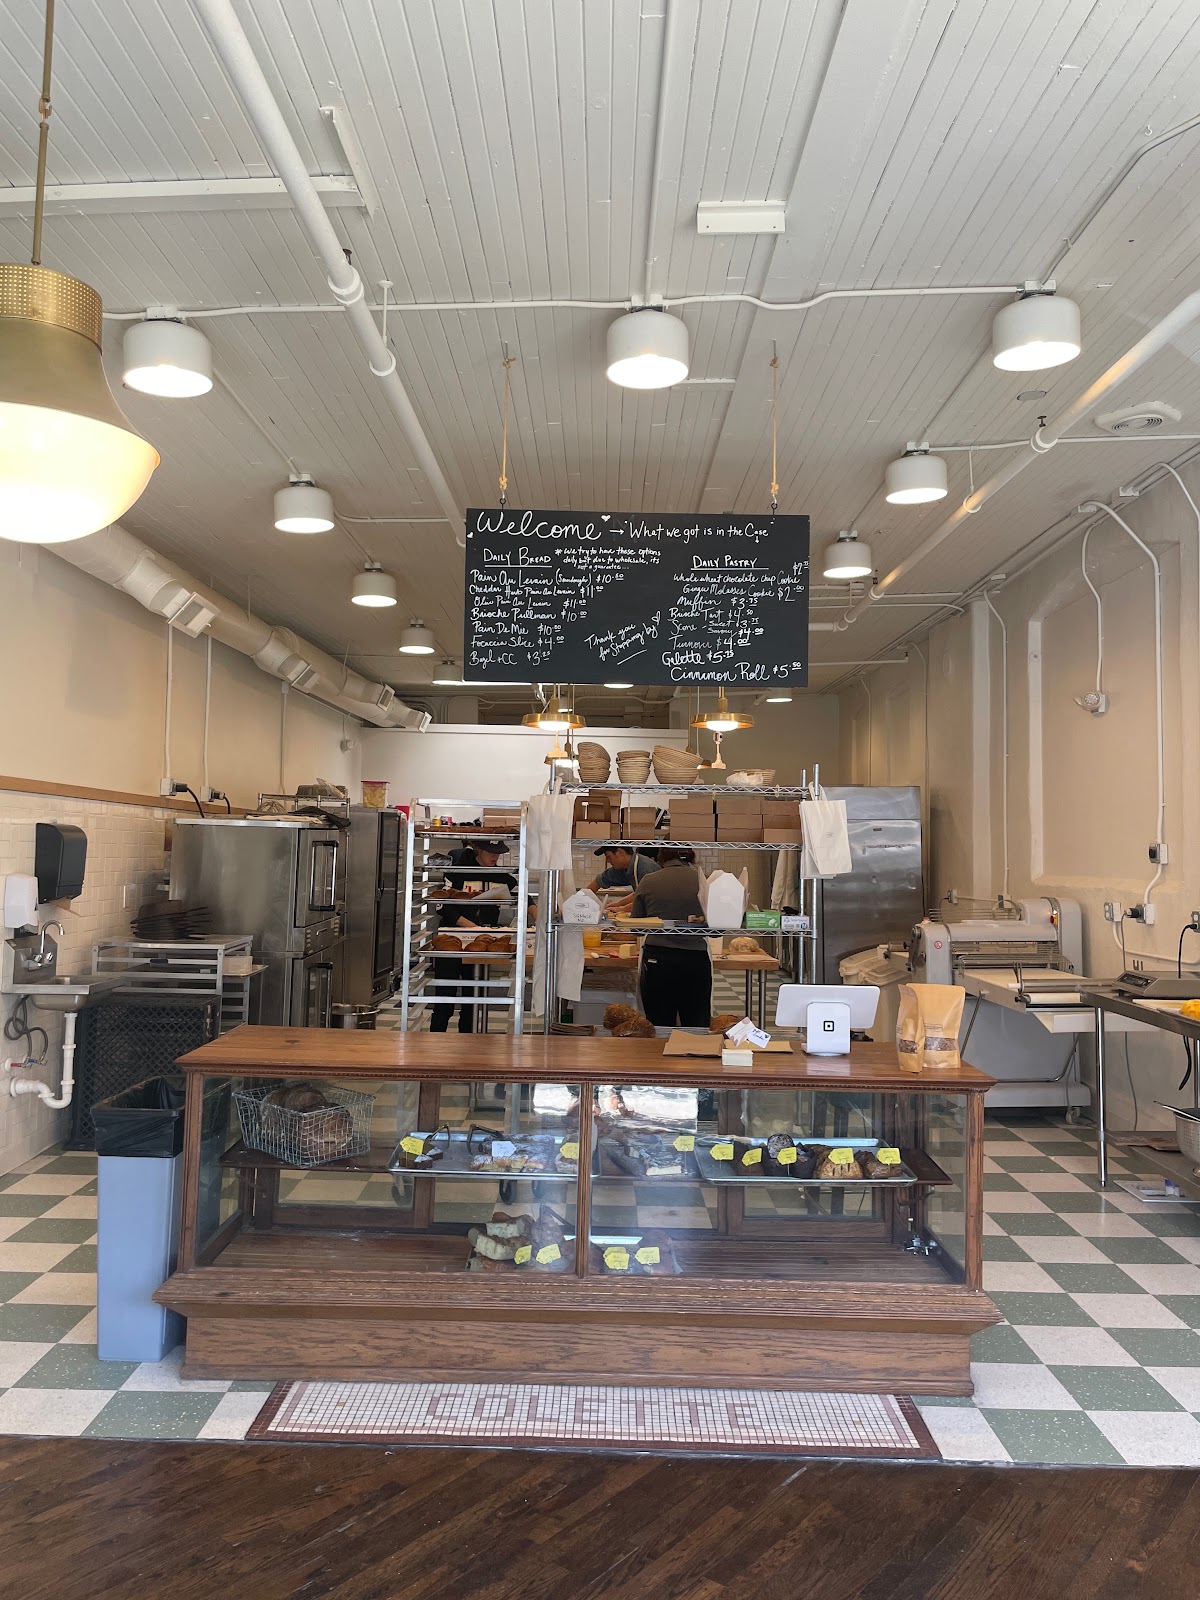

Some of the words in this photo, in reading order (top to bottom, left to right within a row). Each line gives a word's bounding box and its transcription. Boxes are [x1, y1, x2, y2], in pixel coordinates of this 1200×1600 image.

[476, 510, 601, 540] Welcome
[629, 520, 665, 540] What
[666, 527, 682, 538] we
[683, 523, 700, 543] got
[703, 527, 713, 536] is
[716, 526, 725, 537] in
[727, 524, 743, 536] the
[483, 547, 511, 566] DAILY
[518, 546, 552, 567] BREAD
[578, 545, 590, 559] try
[590, 546, 598, 555] to
[598, 546, 616, 555] have
[616, 546, 636, 555] these
[638, 546, 661, 558] options
[562, 555, 578, 567] daily
[692, 555, 719, 569] DAILY
[724, 554, 758, 568] PASTRY
[470, 568, 497, 584] Pain
[499, 570, 516, 586] Au
[518, 569, 553, 587] Levain
[468, 584, 502, 596] Cheddar
[524, 586, 542, 597] Pain
[747, 584, 775, 597] Cookie
[495, 595, 511, 608] Pain
[512, 596, 525, 606] Au
[527, 597, 552, 610] Levain
[676, 595, 722, 611] Muffin
[470, 607, 510, 621] Brioche
[511, 607, 557, 622] Pullman
[472, 621, 496, 634] Pain
[495, 622, 511, 634] De
[511, 623, 529, 635] Mie
[667, 618, 698, 636] Scone
[508, 635, 535, 648] Slice
[584, 629, 617, 650] Thank
[617, 623, 636, 641] you
[599, 646, 611, 662] for
[642, 622, 659, 639] by
[668, 634, 713, 650] Turnover
[670, 667, 737, 682] Cinnamon
[734, 661, 771, 681] Roll
[427, 1392, 765, 1430] COLETTE
